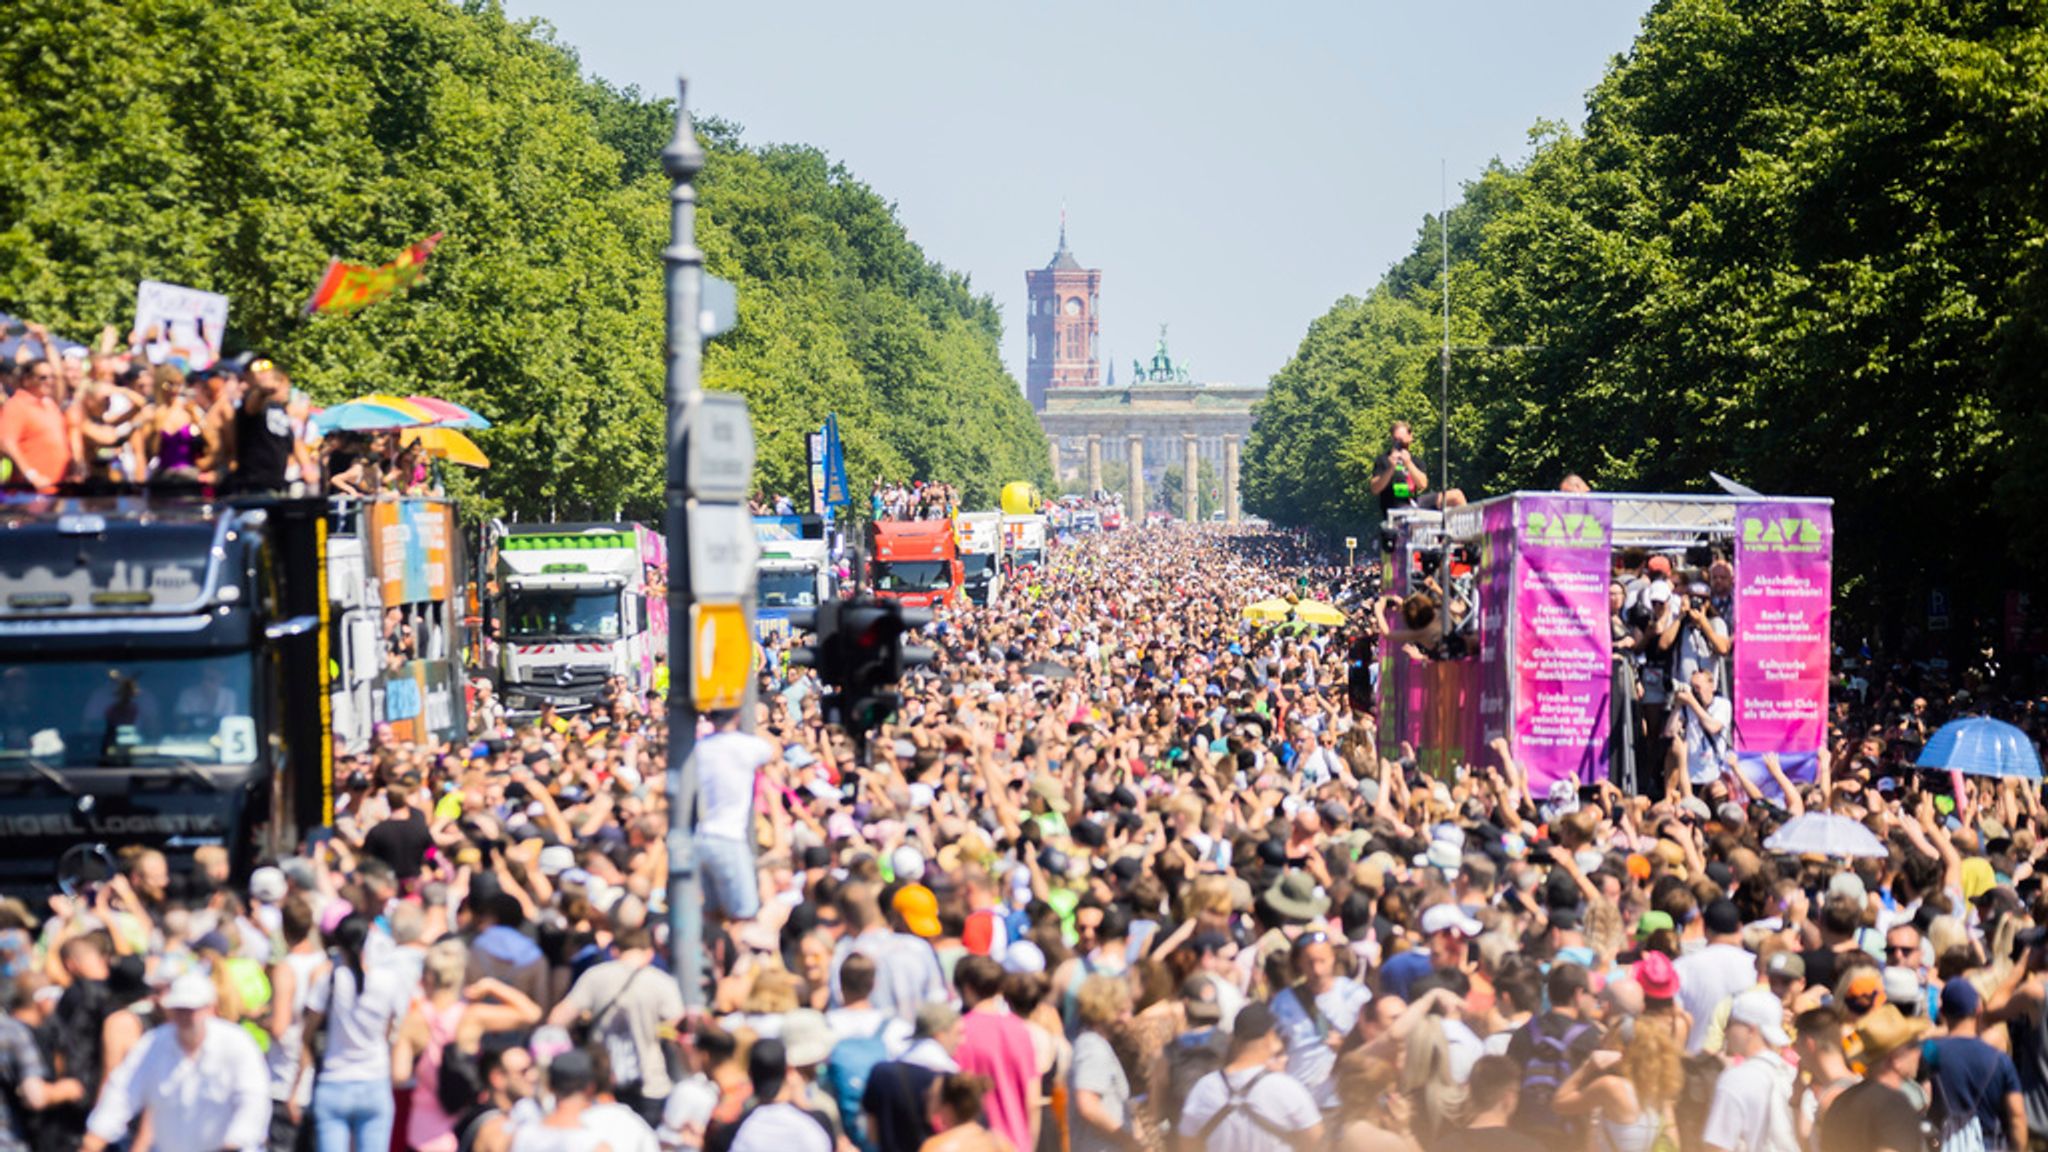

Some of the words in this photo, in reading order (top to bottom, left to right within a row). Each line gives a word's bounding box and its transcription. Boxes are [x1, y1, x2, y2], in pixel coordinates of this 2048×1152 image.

[1743, 518, 1822, 542] RAVE
[1754, 576, 1811, 588] Abschaffung
[1742, 586, 1763, 596] aller
[1761, 610, 1786, 621] Recht
[1788, 610, 1804, 621] auf
[1743, 631, 1821, 642] Demonstrationen!
[1572, 693, 1591, 704] und
[231, 731, 246, 754] 5
[1556, 735, 1574, 746] und
[88, 814, 216, 833] LOGISTIK
